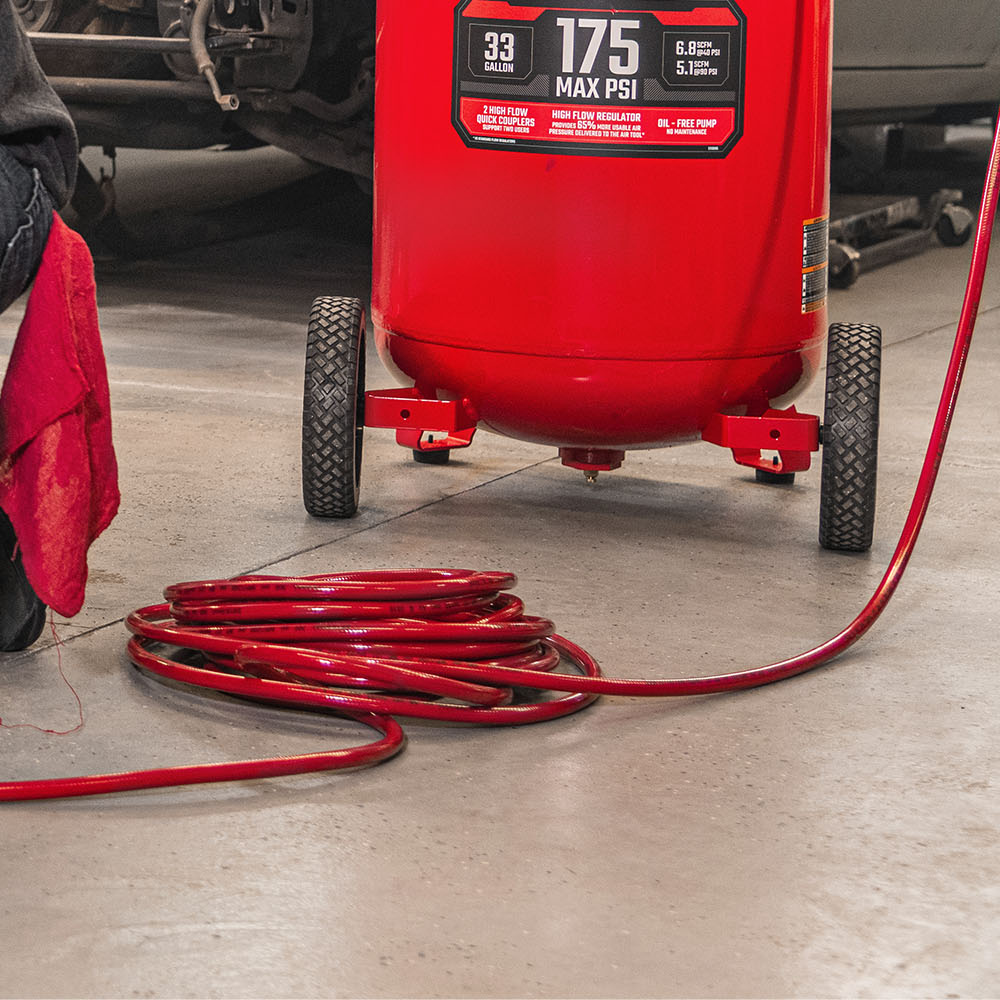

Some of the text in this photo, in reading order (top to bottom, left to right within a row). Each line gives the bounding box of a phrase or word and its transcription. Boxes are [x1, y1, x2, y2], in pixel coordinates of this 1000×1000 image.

[484, 31, 515, 62] 33
[556, 17, 640, 75] 175
[676, 40, 697, 56] 6.8
[484, 62, 514, 73] GALLON
[676, 60, 694, 75] 5.1
[556, 76, 637, 100] MAX PSI
[483, 105, 528, 117] 2 HIGH FLOW
[552, 110, 641, 122] HIGH FLOW REGULATOR
[477, 114, 535, 127] QUICK COUPLERS
[577, 121, 596, 130] 65%
[658, 119, 670, 127] OIL
[677, 119, 695, 128] FREE
[696, 119, 717, 128] PUMP
[549, 128, 574, 136] PRESSURE
